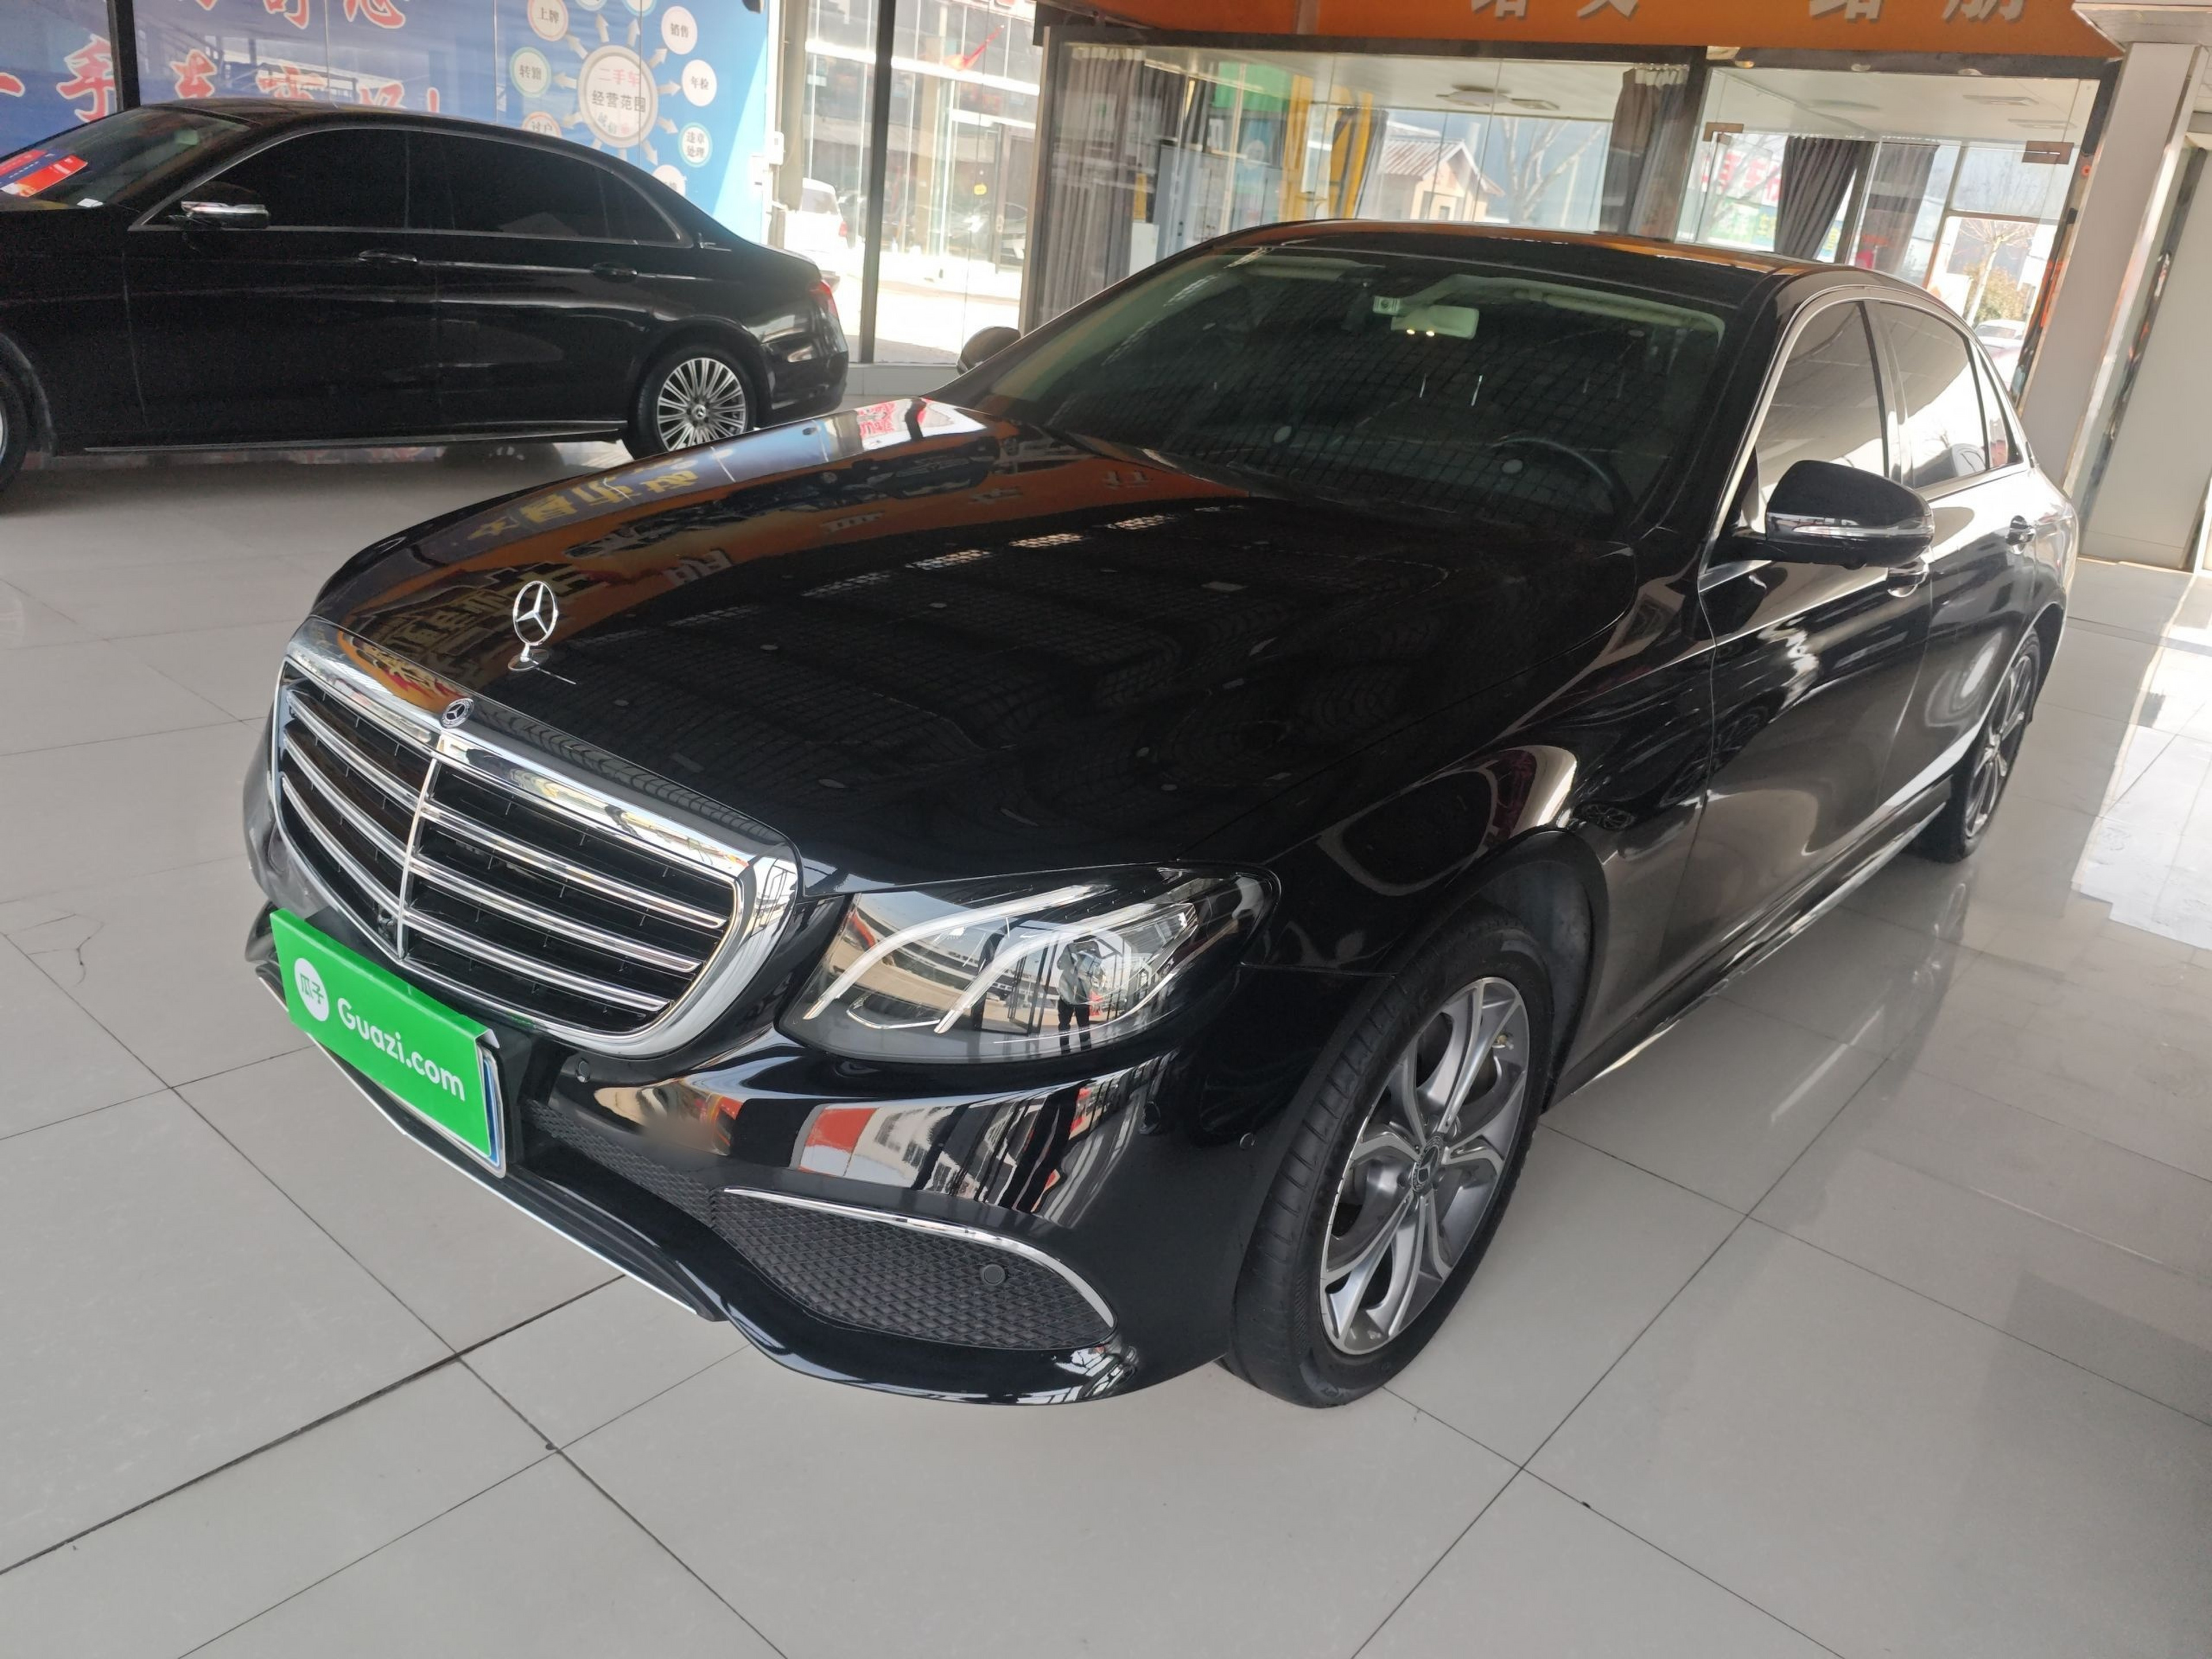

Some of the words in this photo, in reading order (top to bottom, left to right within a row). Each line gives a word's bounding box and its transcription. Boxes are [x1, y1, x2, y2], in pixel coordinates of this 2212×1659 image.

[670, 23, 689, 38] 销售
[598, 67, 641, 86] 二手车
[691, 76, 709, 90] 年检
[592, 90, 646, 112] 经营范围
[686, 145, 704, 158] 处理
[300, 973, 324, 1004] 瓜子
[337, 998, 465, 1101] Guazi.com
